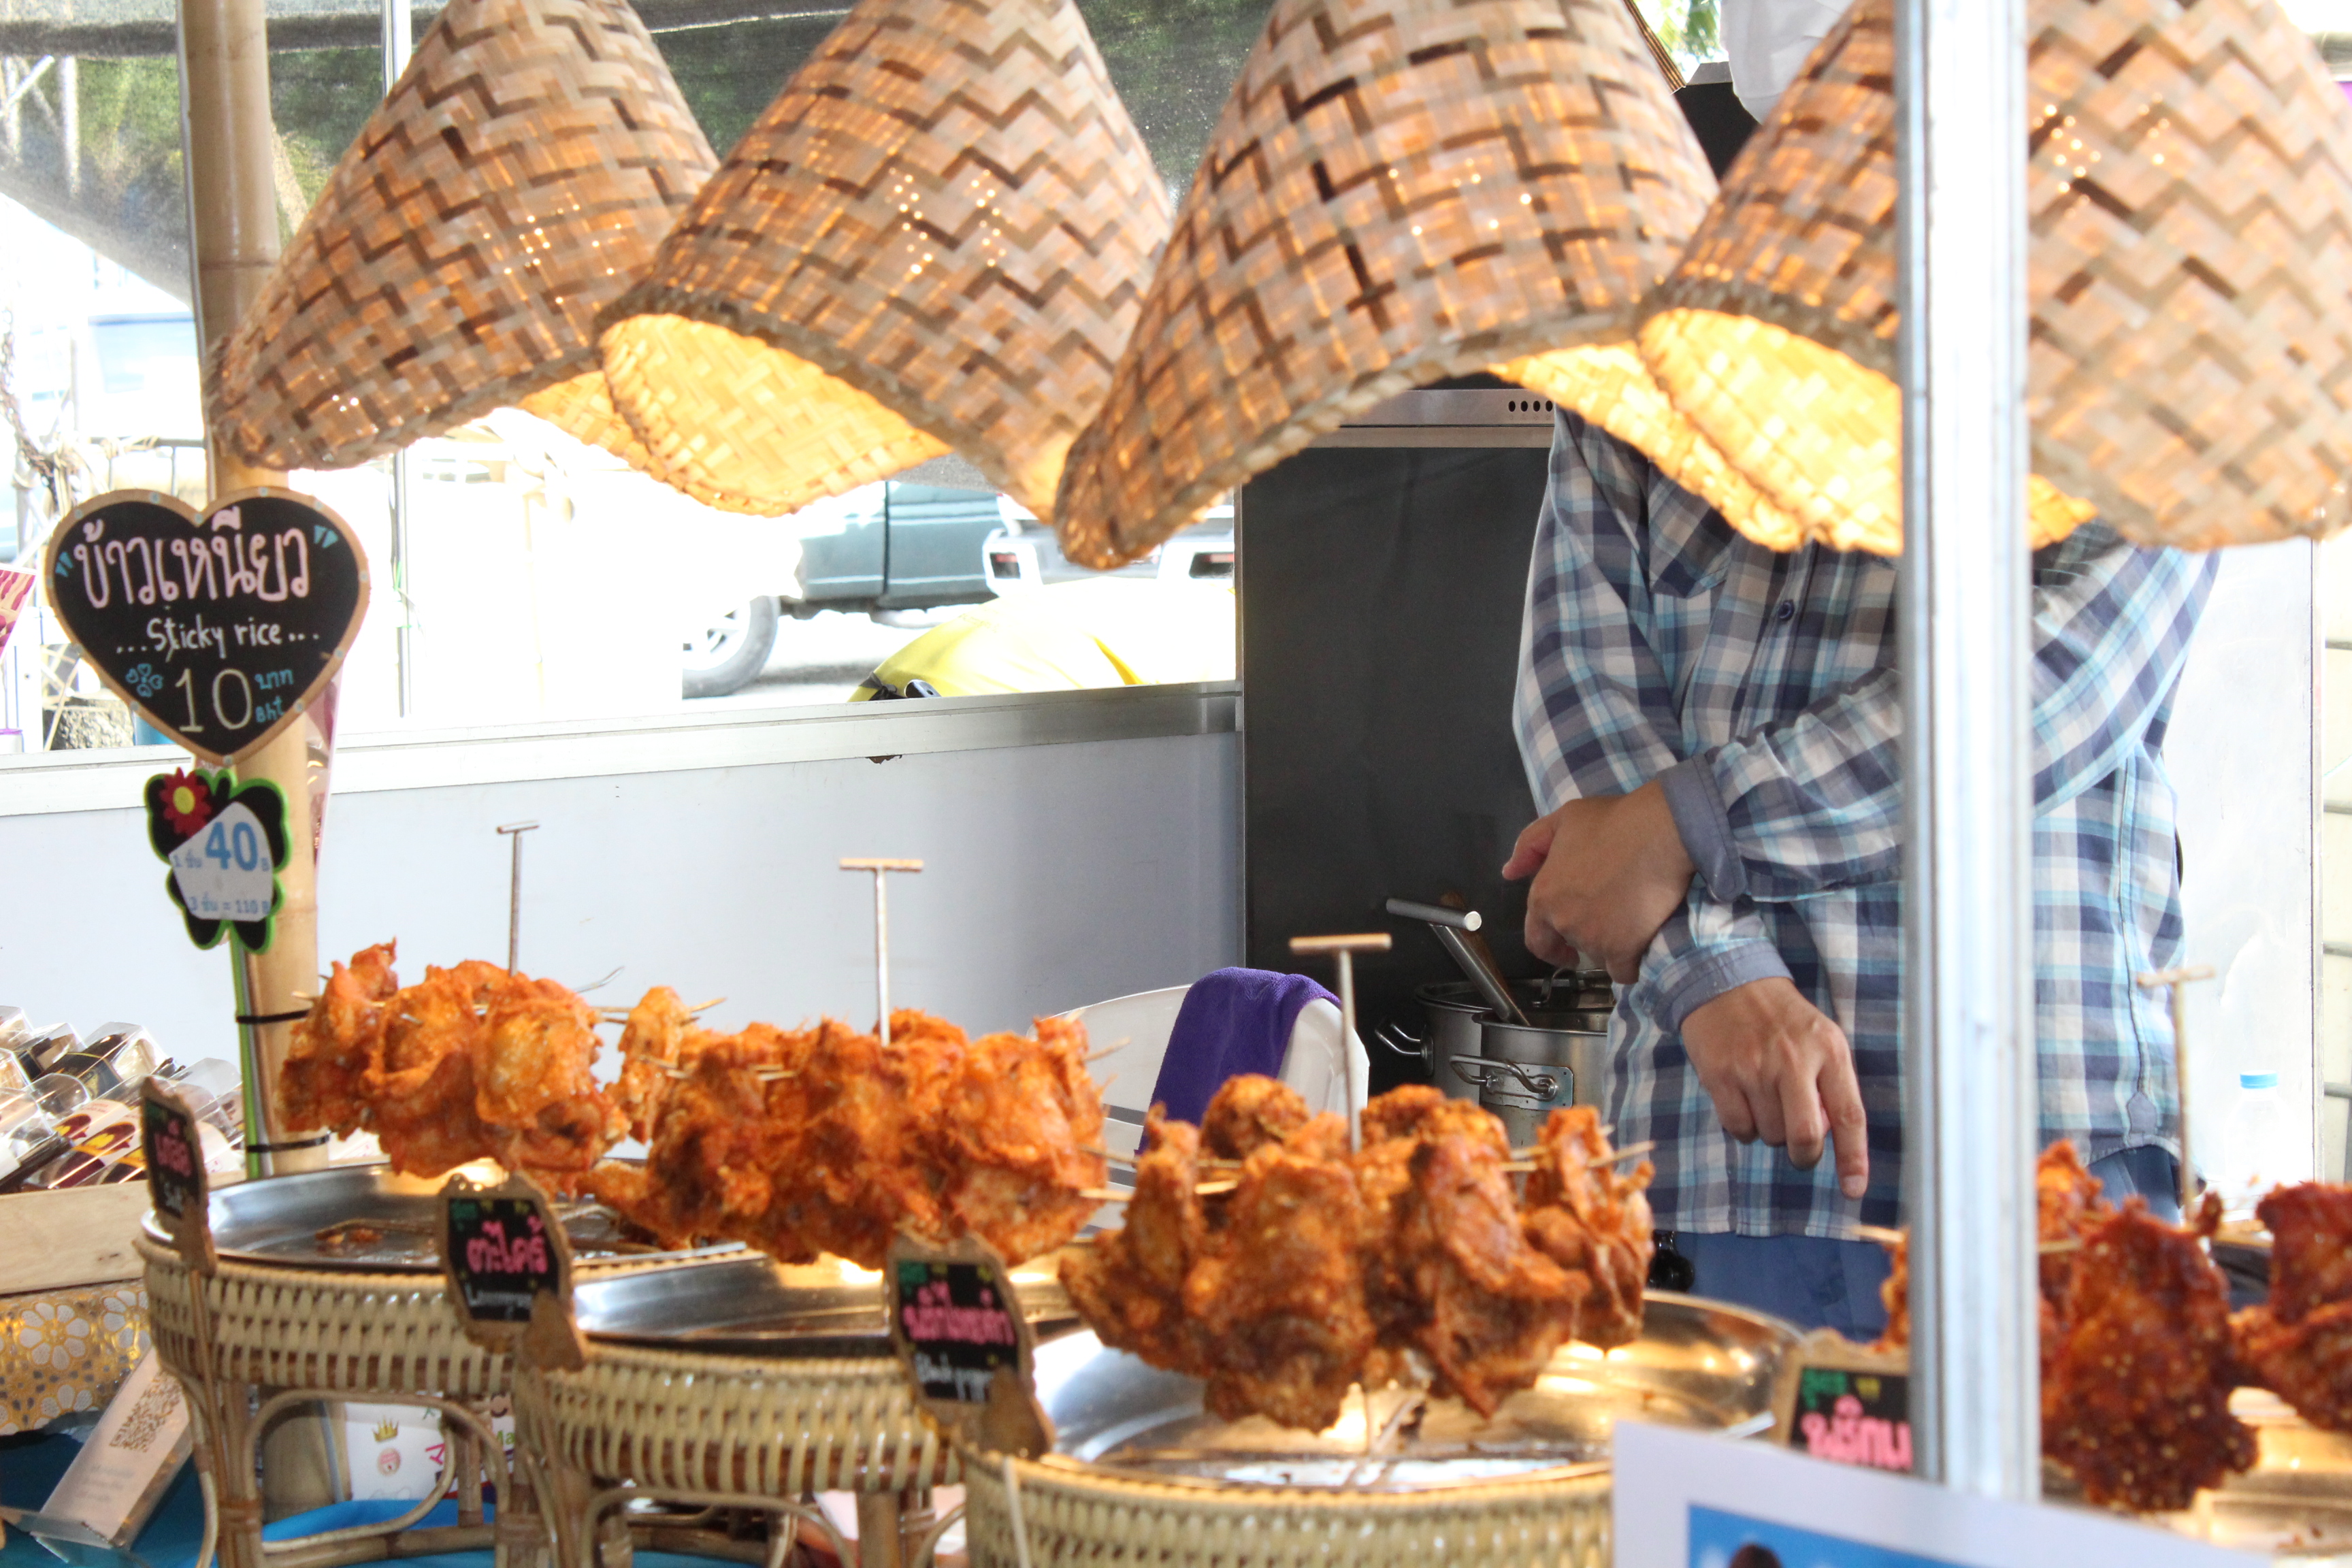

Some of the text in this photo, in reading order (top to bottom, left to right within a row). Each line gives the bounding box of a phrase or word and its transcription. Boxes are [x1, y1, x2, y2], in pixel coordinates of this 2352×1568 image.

[74, 506, 309, 608] ข้าวเหนียว
[175, 668, 253, 733] 10
[255, 668, 294, 689] บาท
[205, 821, 258, 872] 40
